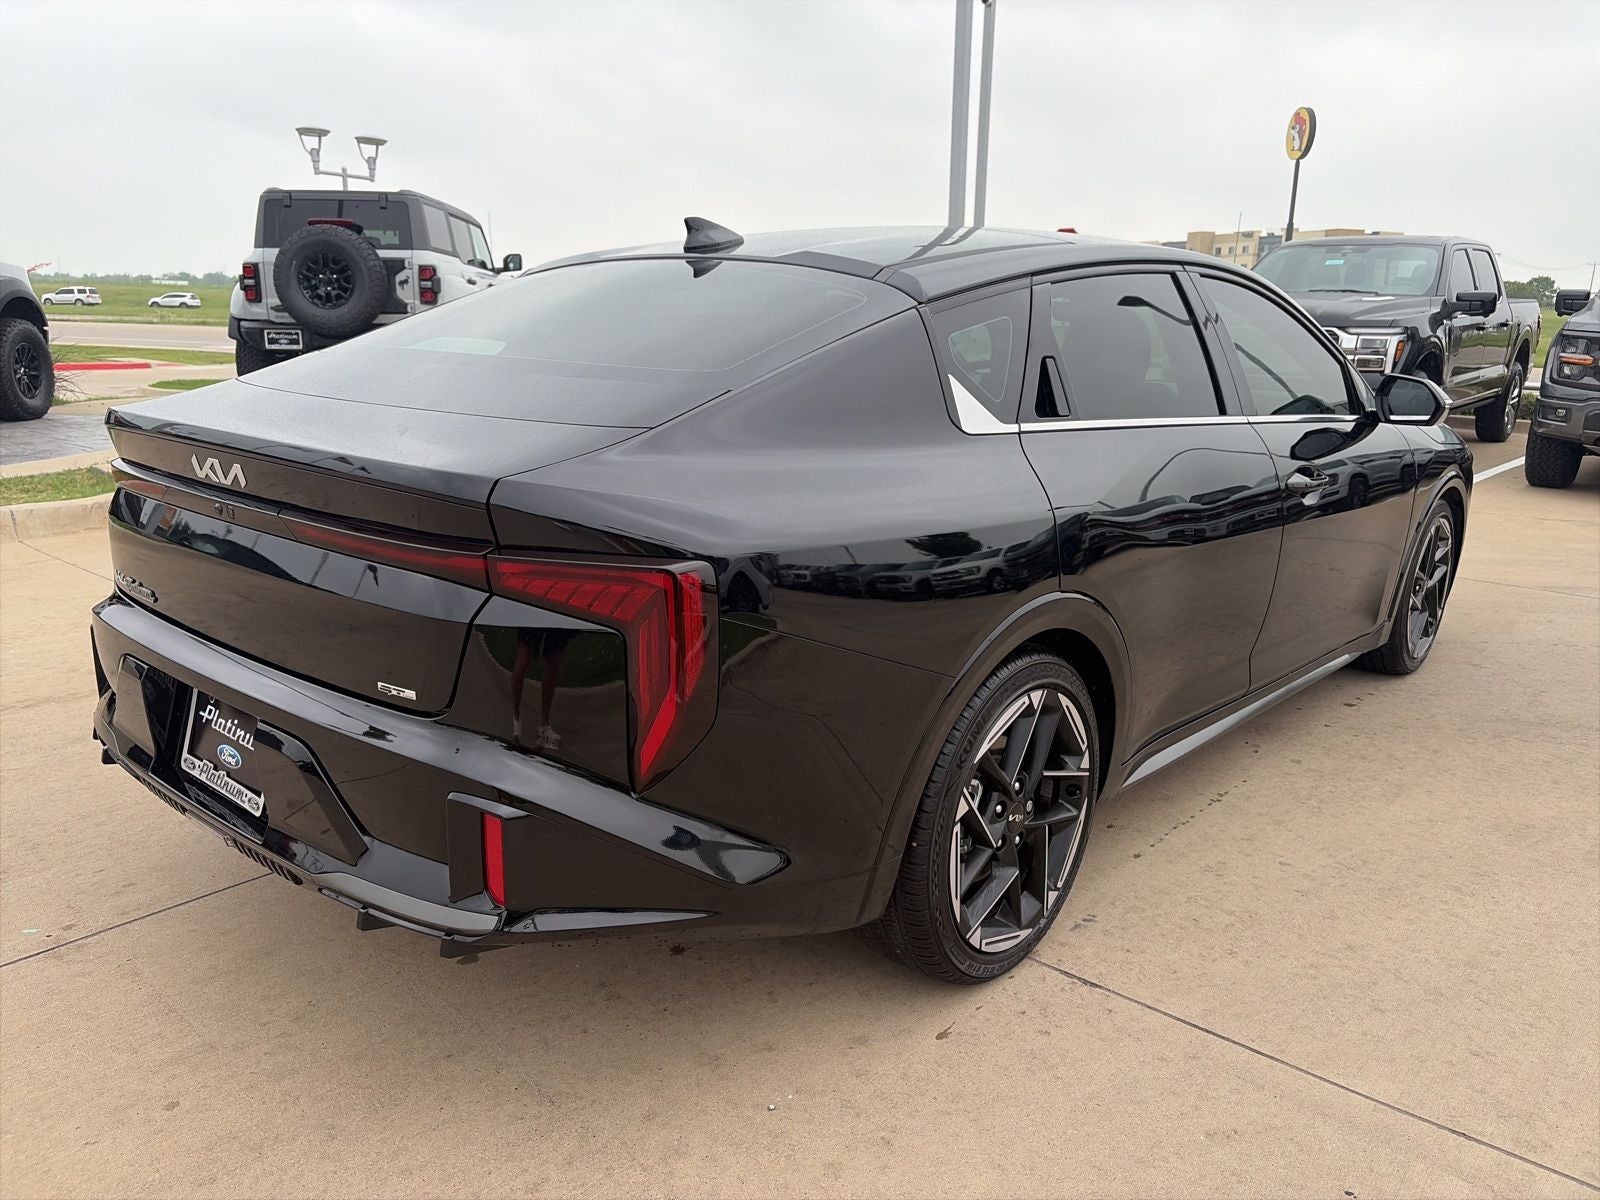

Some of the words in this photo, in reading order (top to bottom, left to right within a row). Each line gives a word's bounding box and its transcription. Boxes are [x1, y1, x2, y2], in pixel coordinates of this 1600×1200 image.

[191, 453, 247, 489] KIA
[199, 704, 255, 751] Platinu
[200, 761, 247, 804] Platinum
